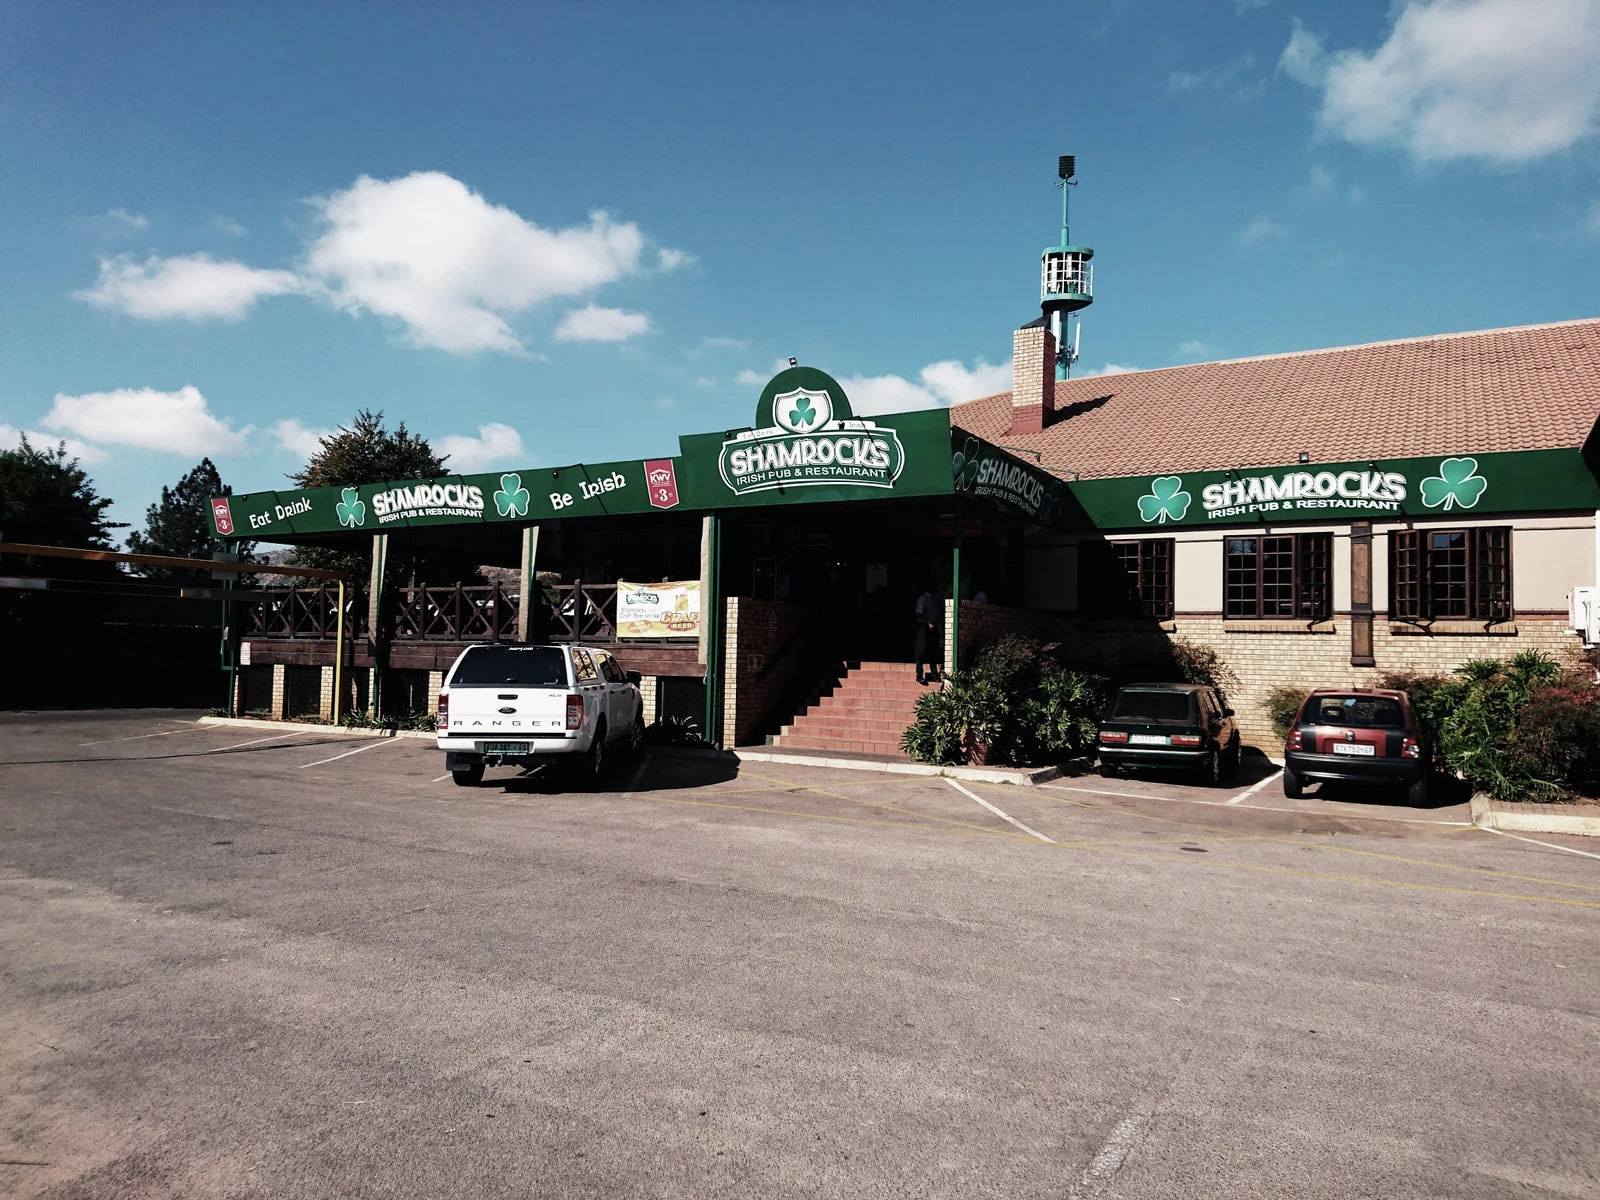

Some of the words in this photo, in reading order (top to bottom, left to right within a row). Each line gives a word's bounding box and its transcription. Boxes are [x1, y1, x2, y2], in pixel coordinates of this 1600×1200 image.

[730, 437, 890, 477] SHAMROCKS
[549, 492, 574, 511] Be
[579, 471, 627, 500] Irish
[650, 473, 671, 484] KWV
[736, 473, 766, 485] IRISH
[768, 469, 791, 479] PUB
[794, 468, 802, 477] &
[805, 466, 886, 478] RESTAURANT
[977, 458, 1044, 509] SHAMROCKS
[1202, 471, 1407, 511] SHAMROCKS
[372, 484, 485, 517] SHAMROCKS
[658, 488, 669, 502] 3
[975, 485, 992, 496] IRISH
[992, 486, 1004, 498] PUB
[1008, 493, 1037, 518] RESTAURANT
[1208, 505, 1246, 519] IRISH
[1250, 502, 1279, 512] PUB
[1282, 501, 1293, 509] &
[1297, 499, 1400, 511] RESTAURANT
[221, 519, 228, 530] 3
[249, 510, 272, 529] Eat
[275, 496, 313, 520] Drink
[379, 512, 400, 524] IRISH
[400, 508, 417, 519] PUB
[418, 508, 425, 516] &
[425, 507, 483, 518] RESTAURANT
